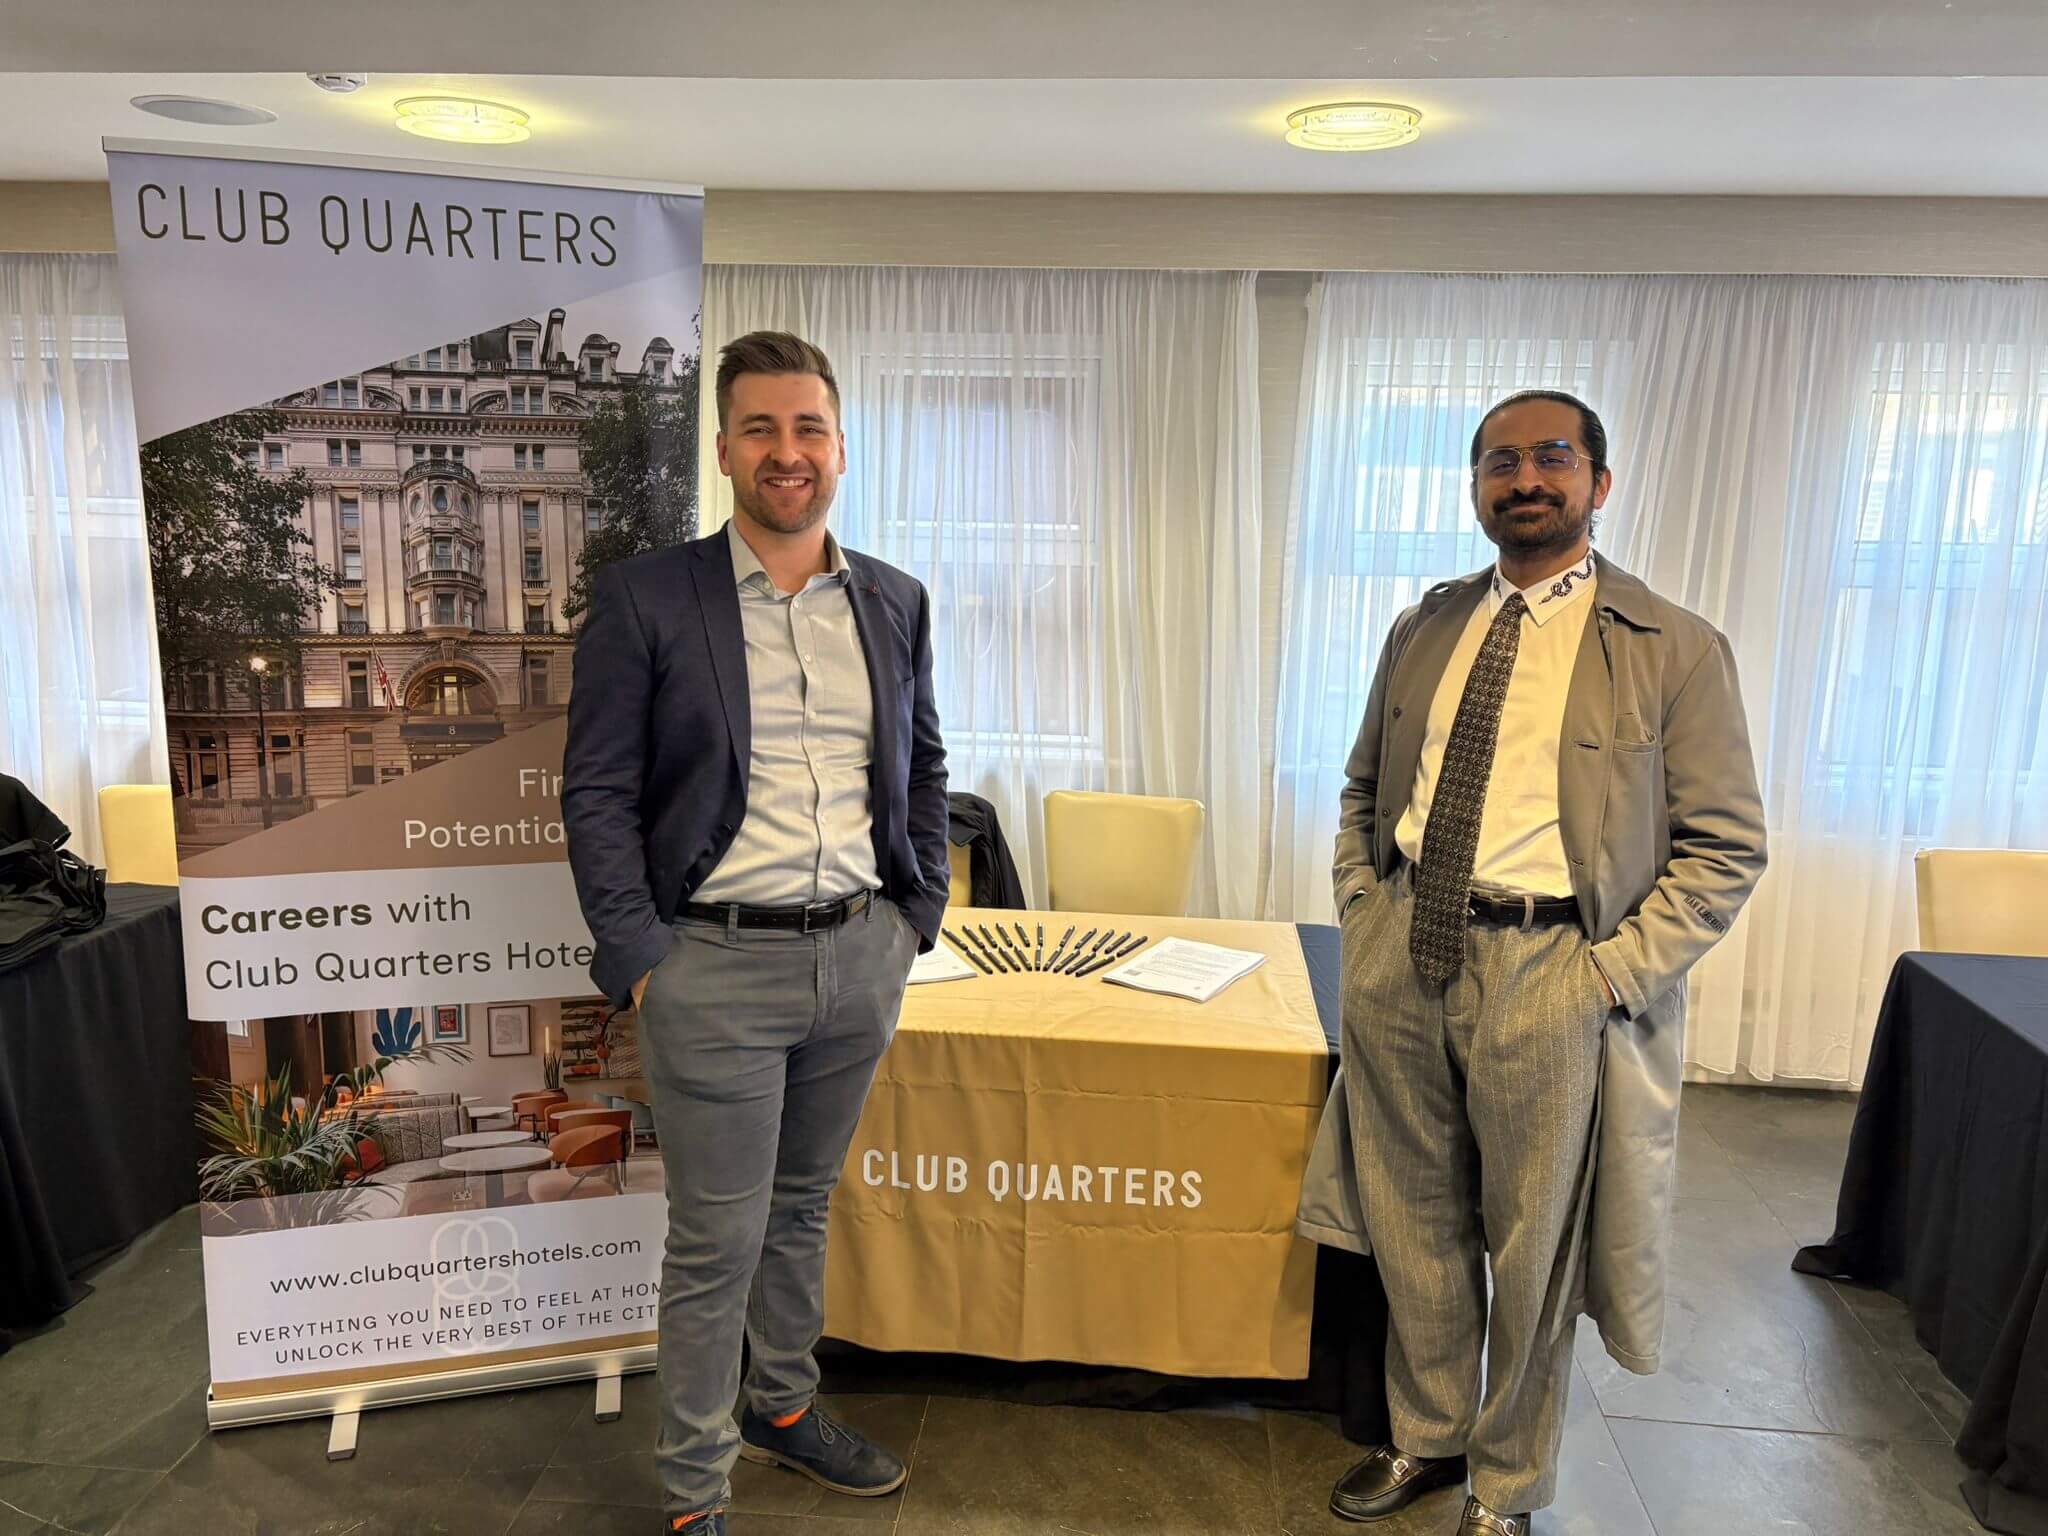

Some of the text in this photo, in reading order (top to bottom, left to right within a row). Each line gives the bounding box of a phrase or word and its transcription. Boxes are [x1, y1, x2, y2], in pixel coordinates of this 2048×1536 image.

[137, 182, 617, 267] CLUB QUARTERS
[405, 816, 565, 848] Potentia
[201, 893, 471, 935] Careers with
[206, 940, 593, 990] Club Quarters Hote
[863, 1149, 1202, 1208] CLUB QUARTERS
[270, 1239, 641, 1294] www.clubquartershotels.com
[237, 1315, 377, 1346] EVERYTHING
[387, 1307, 429, 1326] YOU
[440, 1301, 492, 1319] NEED
[502, 1298, 527, 1314] TO
[537, 1291, 582, 1309] FEEL
[592, 1287, 612, 1302] AT
[275, 1304, 656, 1365] UNLOCK THE VERY BEST OF THE CIT
